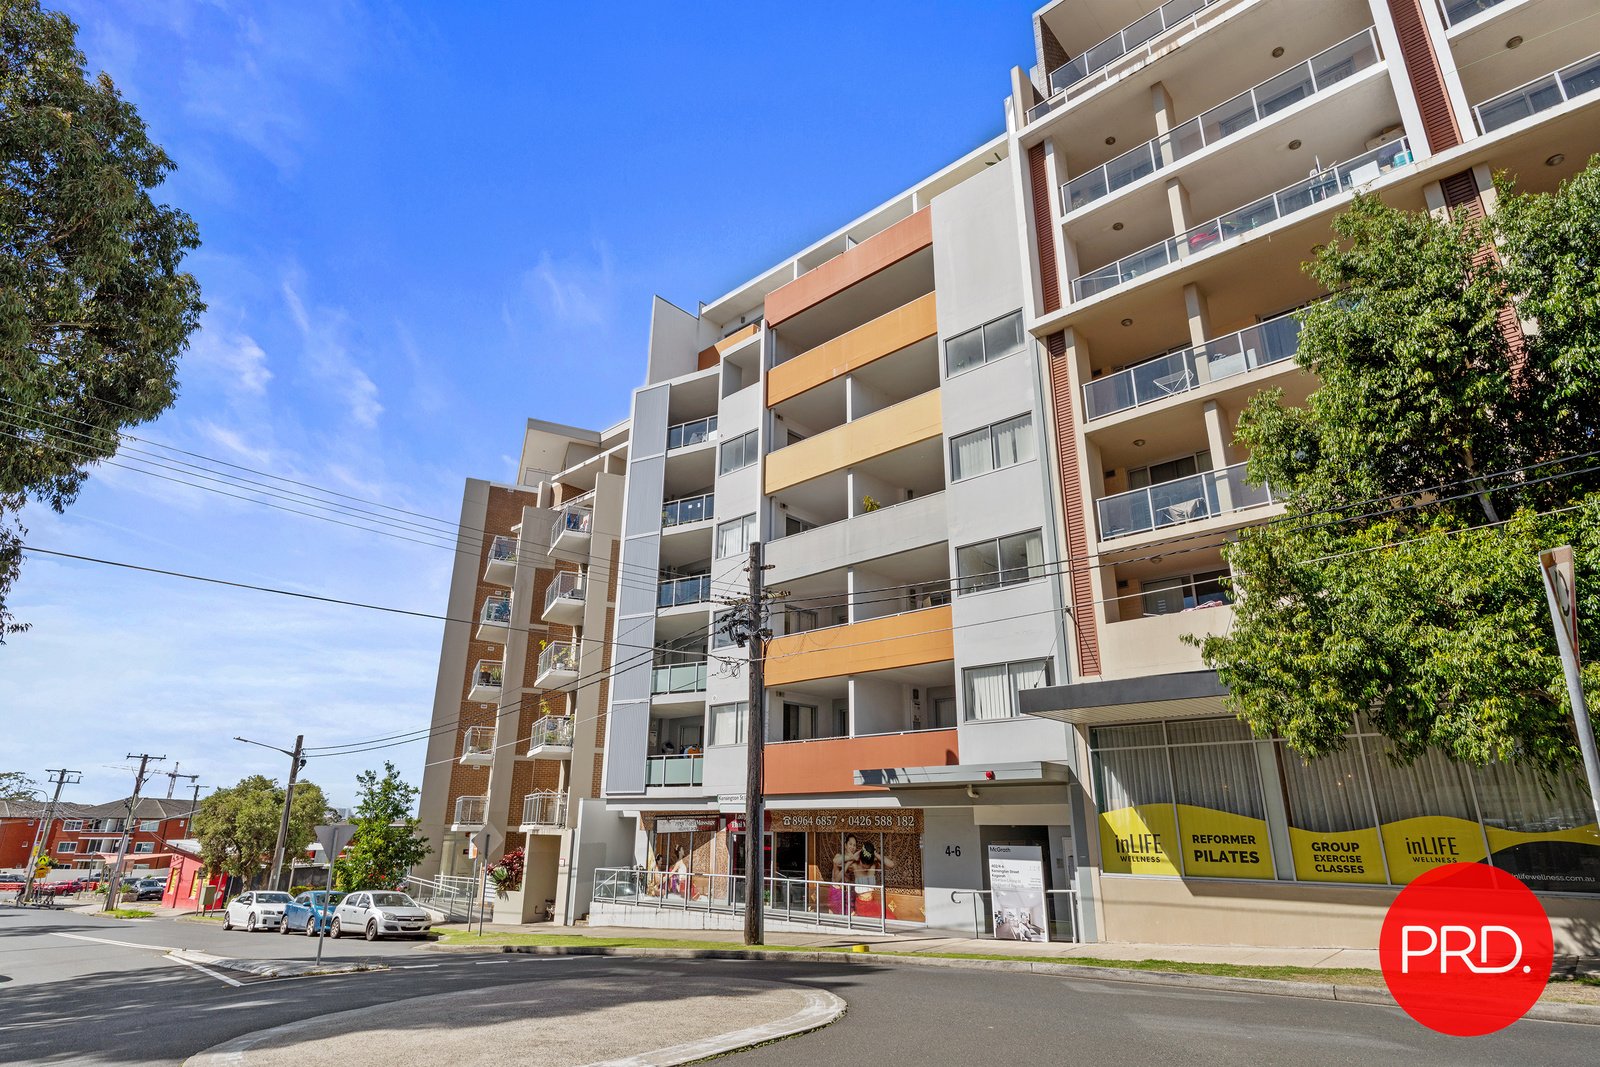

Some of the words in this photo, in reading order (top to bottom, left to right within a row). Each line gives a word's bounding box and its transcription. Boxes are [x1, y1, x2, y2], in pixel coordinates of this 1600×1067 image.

[792, 816, 813, 826] 8964
[815, 816, 838, 826] 6857
[848, 816, 872, 826] 0426
[874, 816, 893, 826] 588
[896, 816, 915, 826] 182
[1115, 834, 1163, 854] inLIFE
[1192, 834, 1257, 845] REFORMER
[945, 845, 961, 857] 4-6
[1311, 842, 1360, 853] GROUP
[1405, 836, 1460, 856] inLIFE
[1193, 850, 1260, 864] PILATES
[1313, 854, 1363, 864] EXERCISE
[1315, 864, 1365, 874] CLASSES
